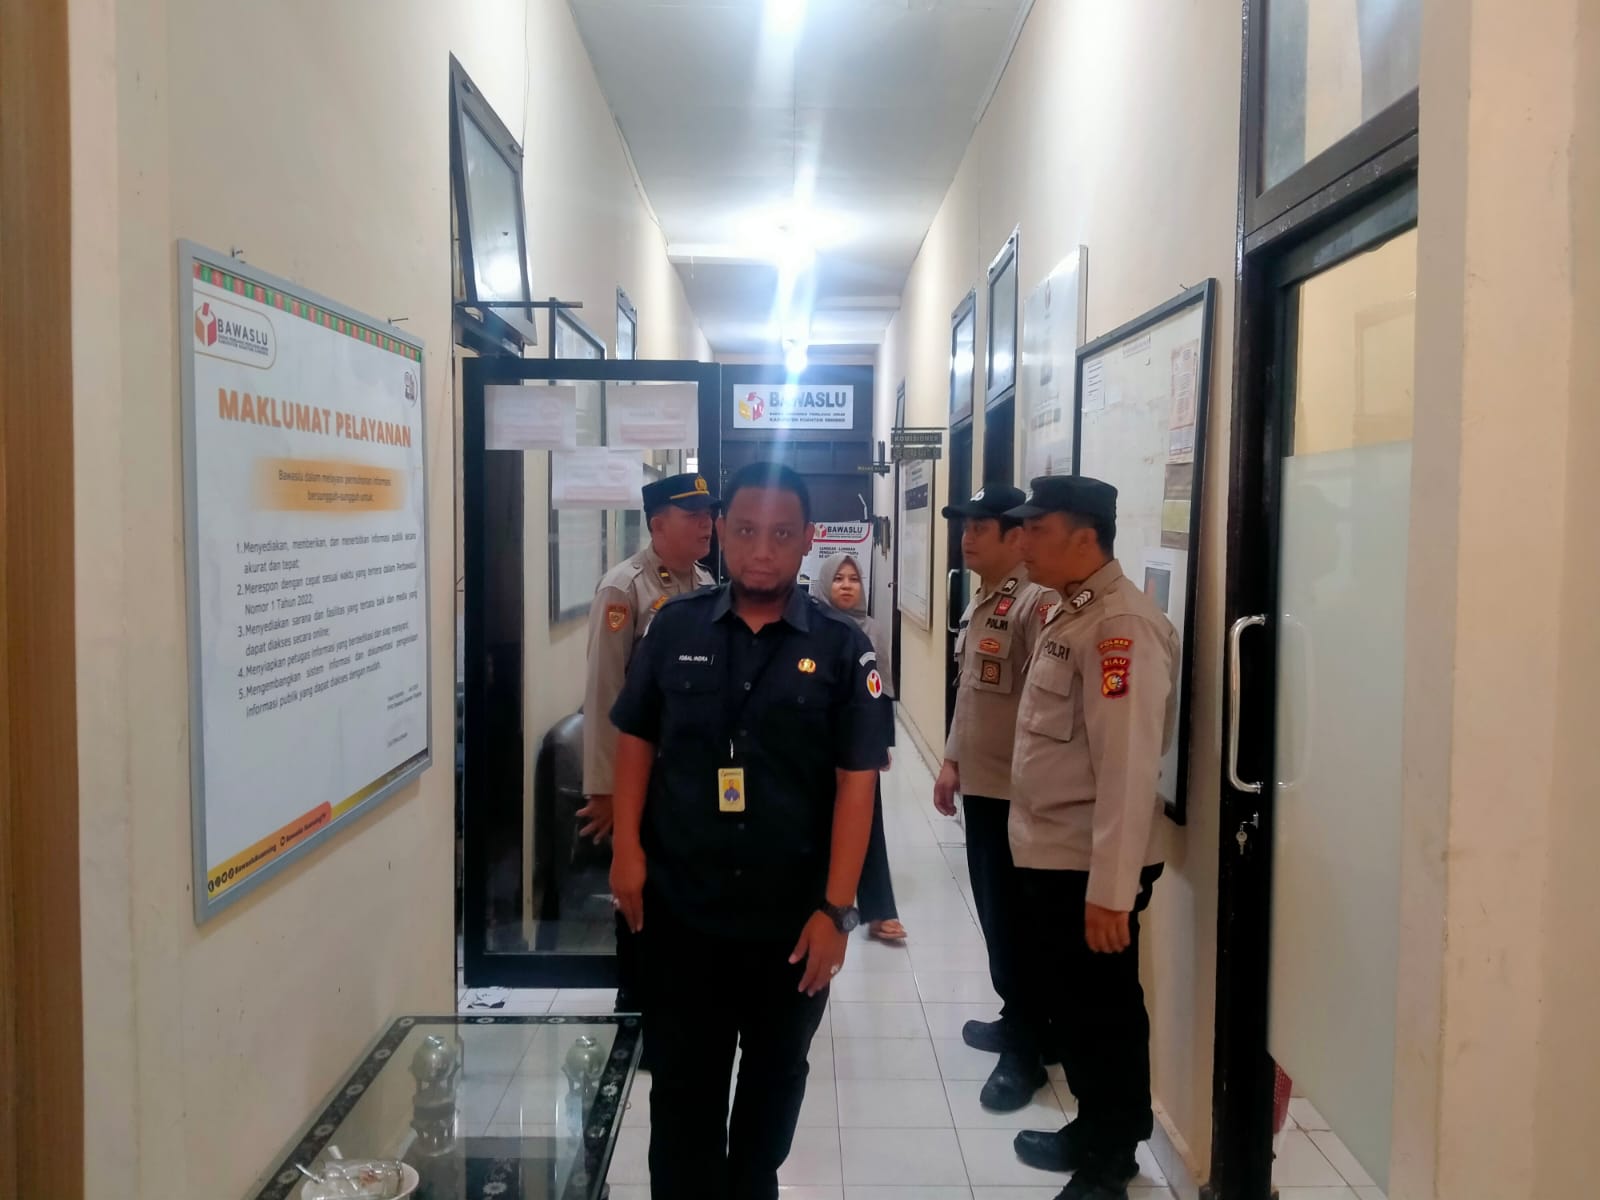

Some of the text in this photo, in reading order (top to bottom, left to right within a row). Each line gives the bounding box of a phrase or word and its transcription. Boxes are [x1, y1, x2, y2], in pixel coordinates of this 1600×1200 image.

[217, 319, 268, 346] BAWASLU
[218, 388, 412, 448] MAKLUMAT PELAYANAN
[827, 526, 863, 534] BAWASLU
[244, 561, 268, 575] akurat
[268, 560, 281, 572] dan
[244, 581, 279, 595] Merespon
[244, 602, 270, 616] Nomor
[276, 598, 297, 610] Tahun
[245, 618, 290, 637] Menyediakan
[984, 617, 1009, 631] POLRI
[245, 642, 267, 657] dapat
[267, 637, 292, 652] diakses
[292, 632, 313, 646] secara
[245, 657, 286, 678] Menyiapkan
[287, 650, 311, 668] petugas
[1103, 658, 1127, 666] RIAU
[246, 672, 302, 698] Mengembangkan
[279, 689, 299, 710] publik
